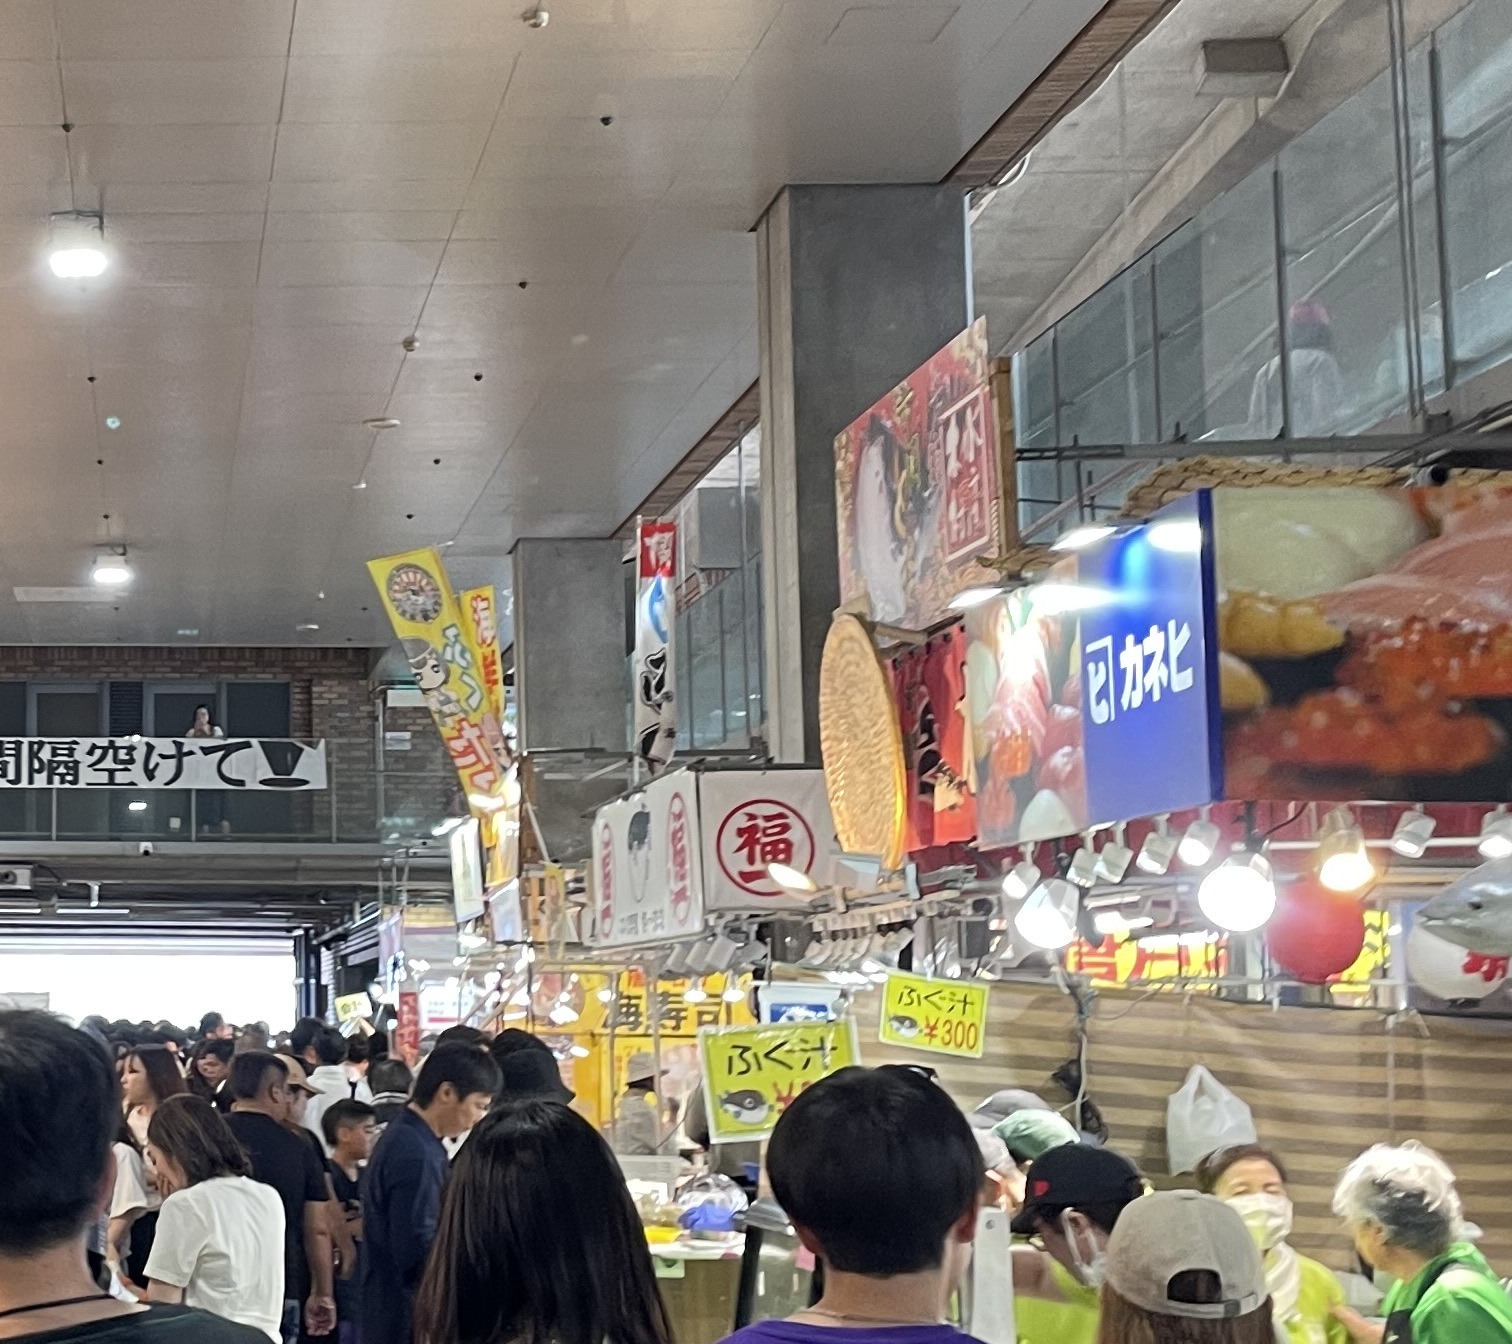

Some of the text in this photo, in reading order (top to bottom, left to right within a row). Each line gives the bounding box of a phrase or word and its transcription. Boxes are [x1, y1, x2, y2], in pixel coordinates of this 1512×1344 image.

[1119, 618, 1194, 712] カネヒ
[923, 1016, 978, 1050] ¥300
